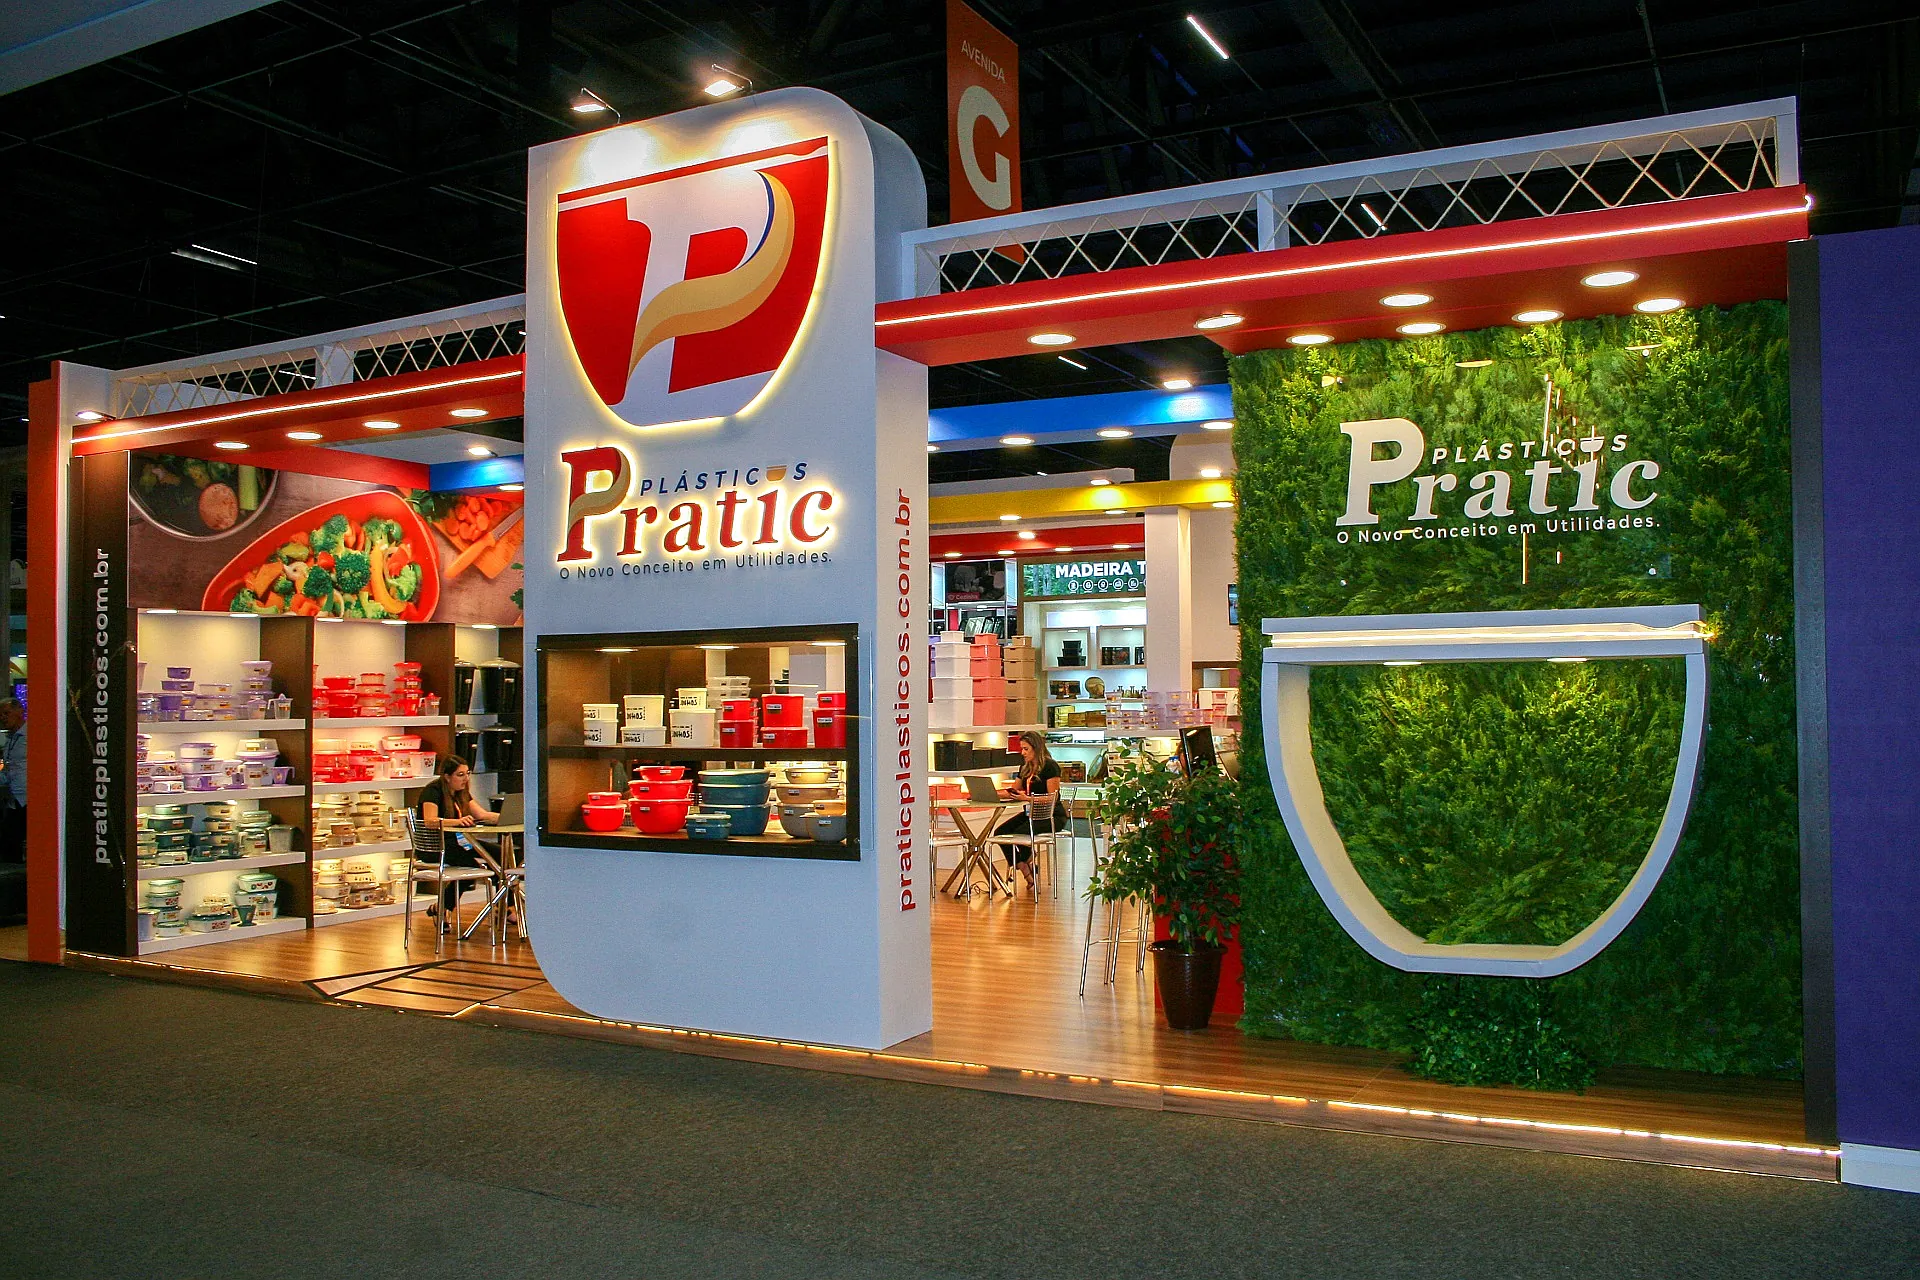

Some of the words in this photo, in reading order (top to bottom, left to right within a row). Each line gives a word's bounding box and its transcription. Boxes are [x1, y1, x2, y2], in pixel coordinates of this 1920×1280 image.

[961, 40, 1006, 84] AVENIDA
[957, 85, 1012, 211] G
[557, 446, 834, 562] Pratic
[1335, 417, 1661, 527] Pratic
[559, 566, 570, 580] O
[577, 565, 614, 579] Novo
[621, 558, 694, 577] Conceito
[702, 558, 726, 571] em
[735, 549, 832, 569] Utilidades.
[1055, 561, 1134, 579] MADEIRA
[1336, 531, 1349, 544] O
[1358, 529, 1403, 543] Novo
[1412, 522, 1498, 540] Conceito
[1507, 522, 1536, 535] em
[1546, 514, 1661, 533] Utilidades.
[92, 548, 111, 864] praticplasticos.com.br
[894, 488, 917, 912] praticplasticos.com.br
